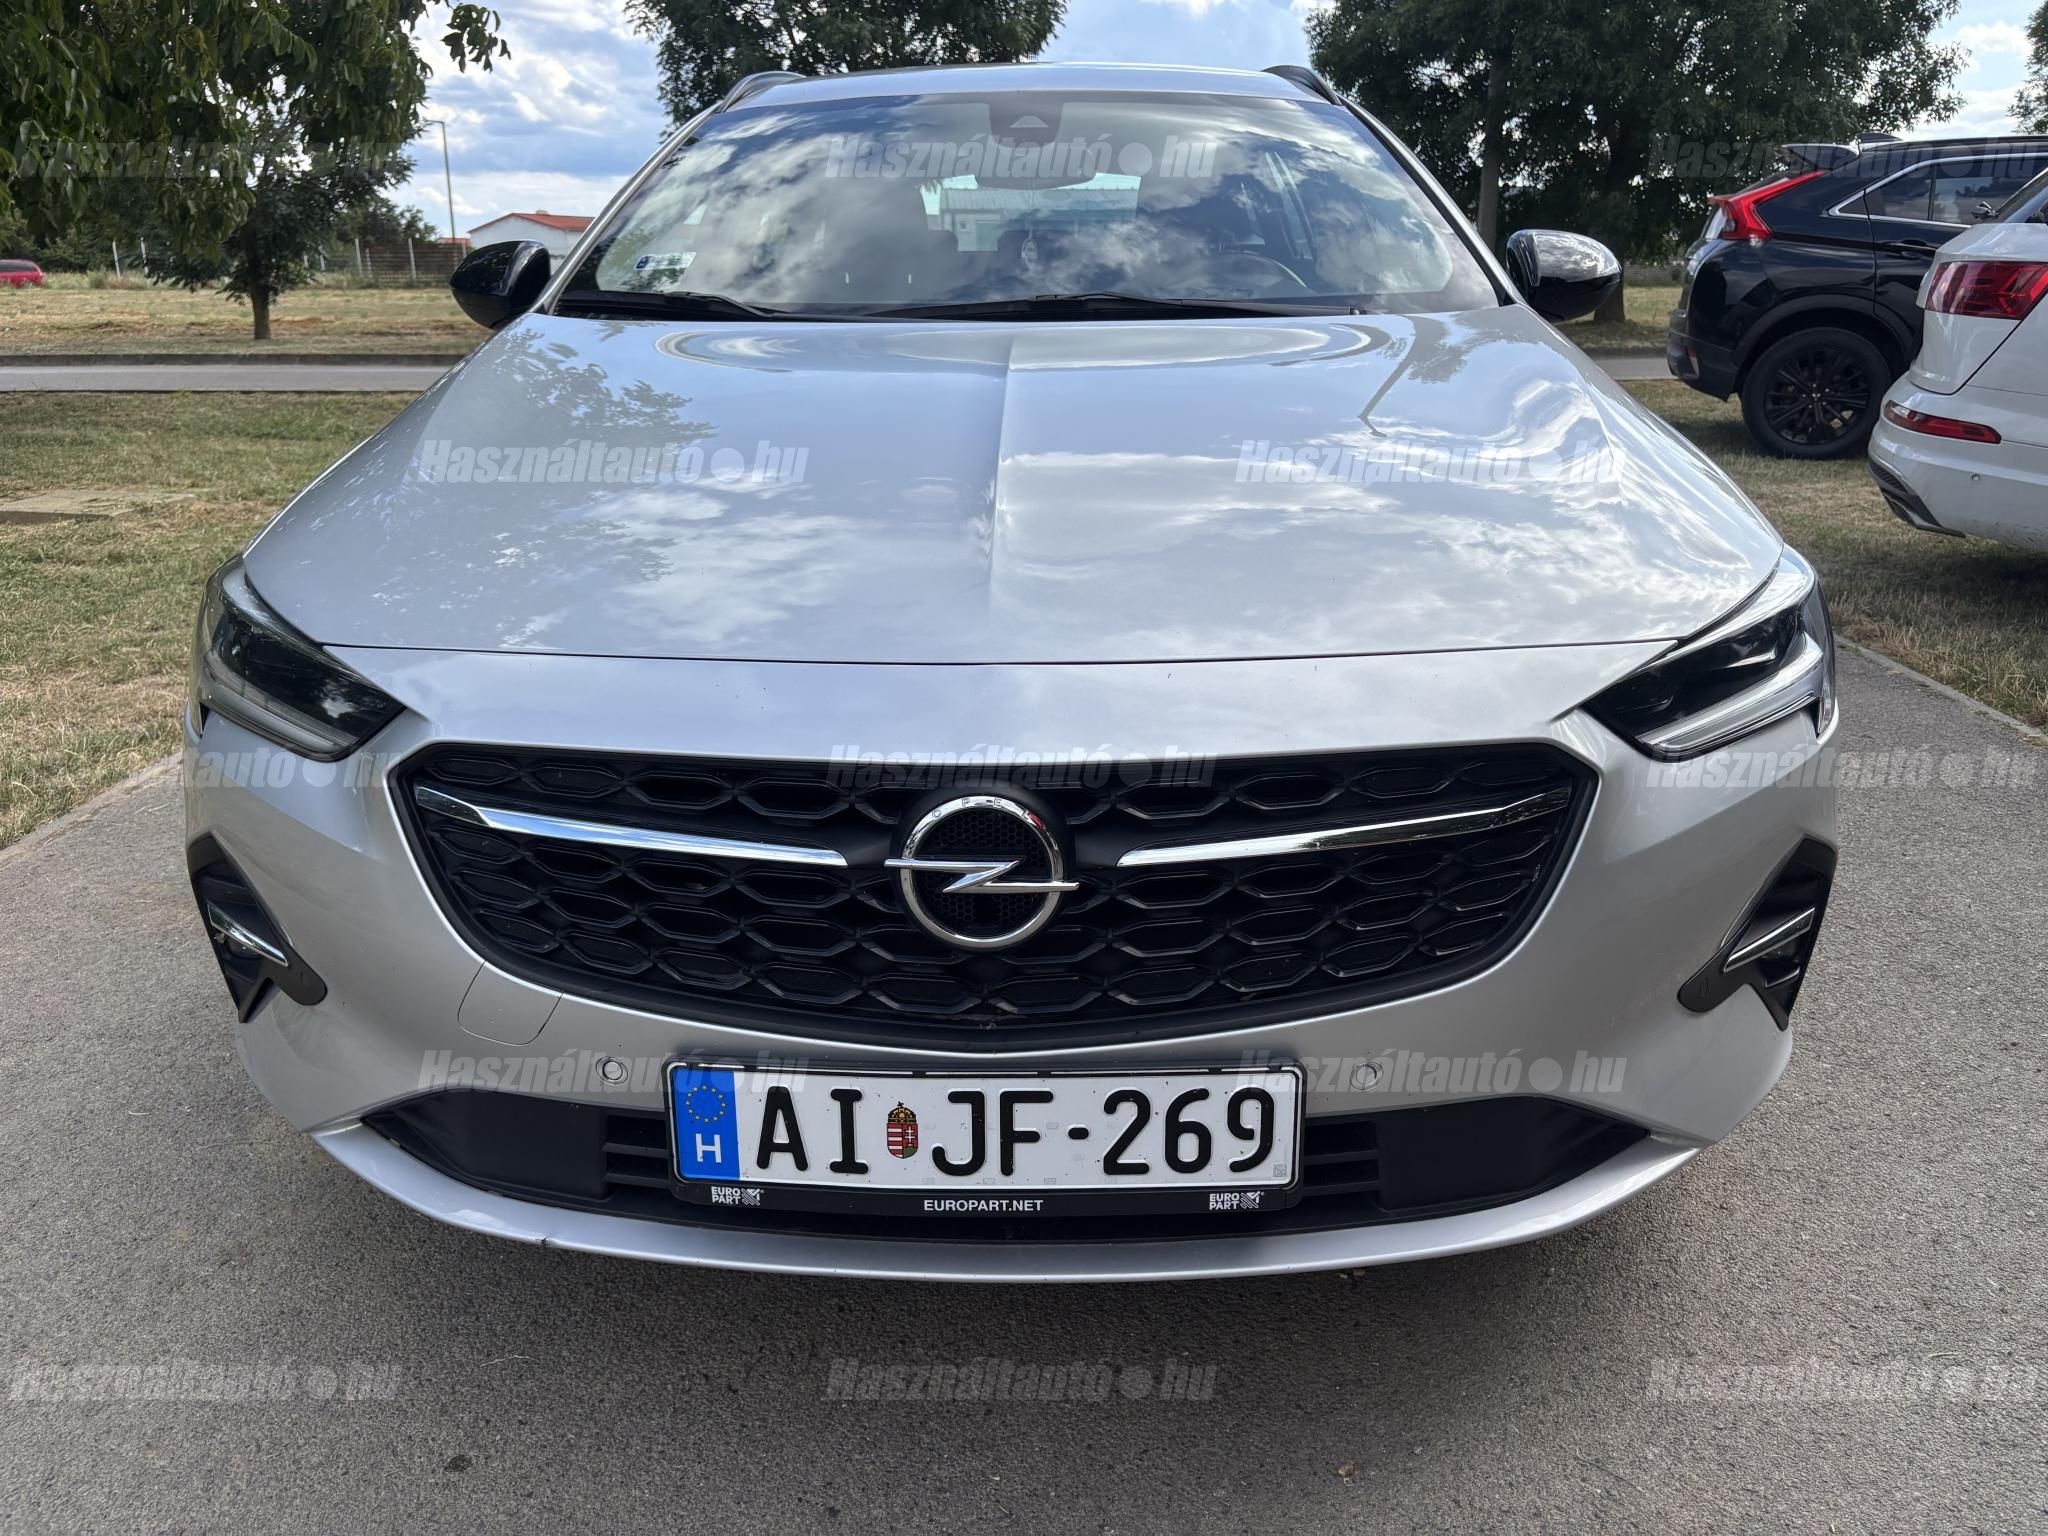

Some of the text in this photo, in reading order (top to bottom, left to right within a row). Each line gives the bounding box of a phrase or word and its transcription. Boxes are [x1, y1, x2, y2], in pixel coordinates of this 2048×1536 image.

[755, 1085, 1275, 1177] AI JF-269
[695, 1133, 722, 1163] H
[711, 1186, 741, 1196] EURO
[711, 1195, 741, 1205] PART
[1209, 1192, 1240, 1202] EURO
[923, 1199, 1044, 1212] EUROPART.NET
[1209, 1200, 1240, 1210] PART
